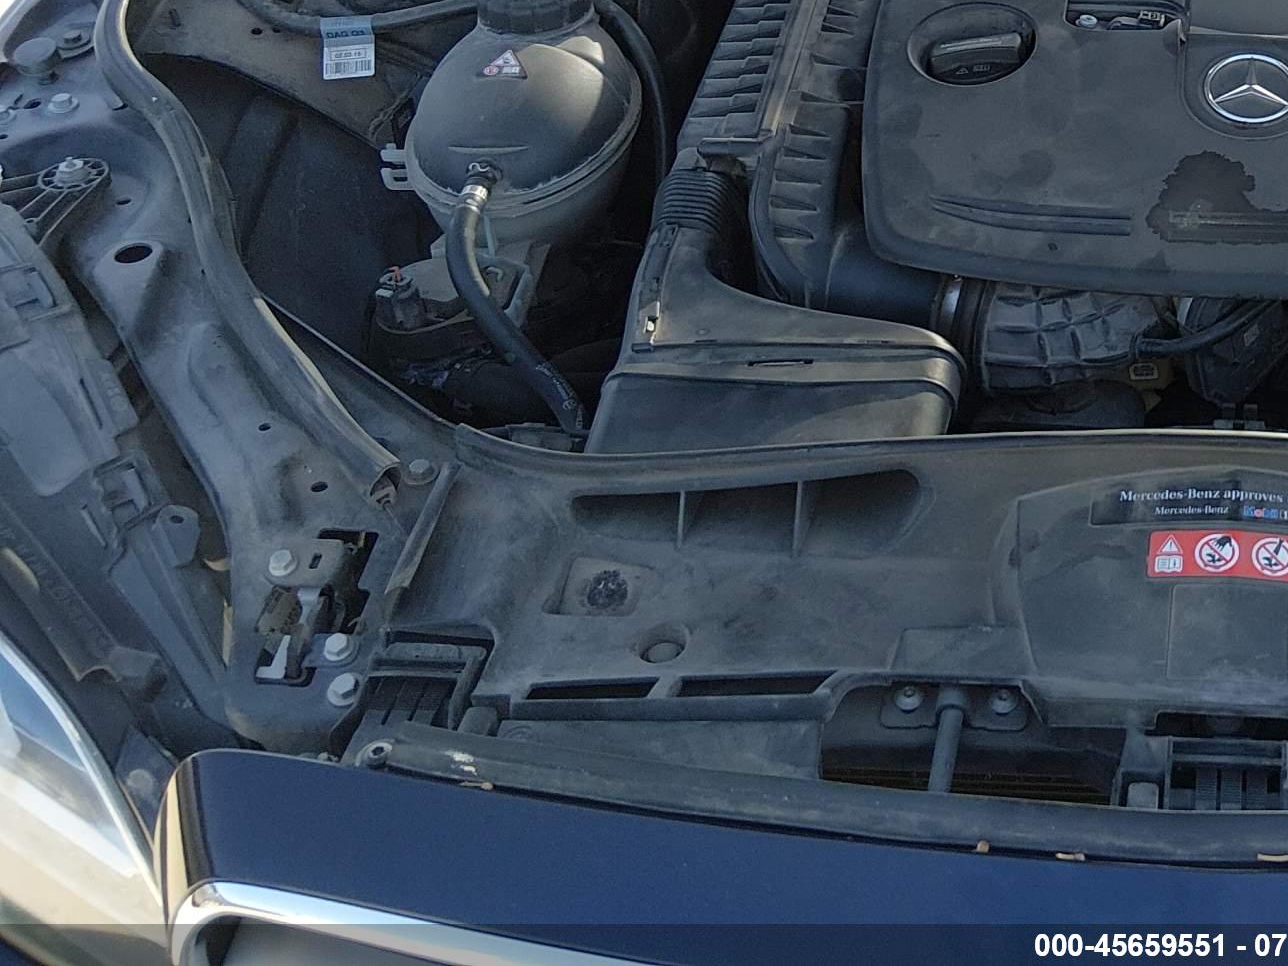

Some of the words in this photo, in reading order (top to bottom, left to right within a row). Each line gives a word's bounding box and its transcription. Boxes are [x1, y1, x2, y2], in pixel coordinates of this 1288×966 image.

[1120, 488, 1220, 502] Mercedes-Benz
[1223, 490, 1283, 506] approves
[1154, 504, 1230, 516] Mercedes-Benz
